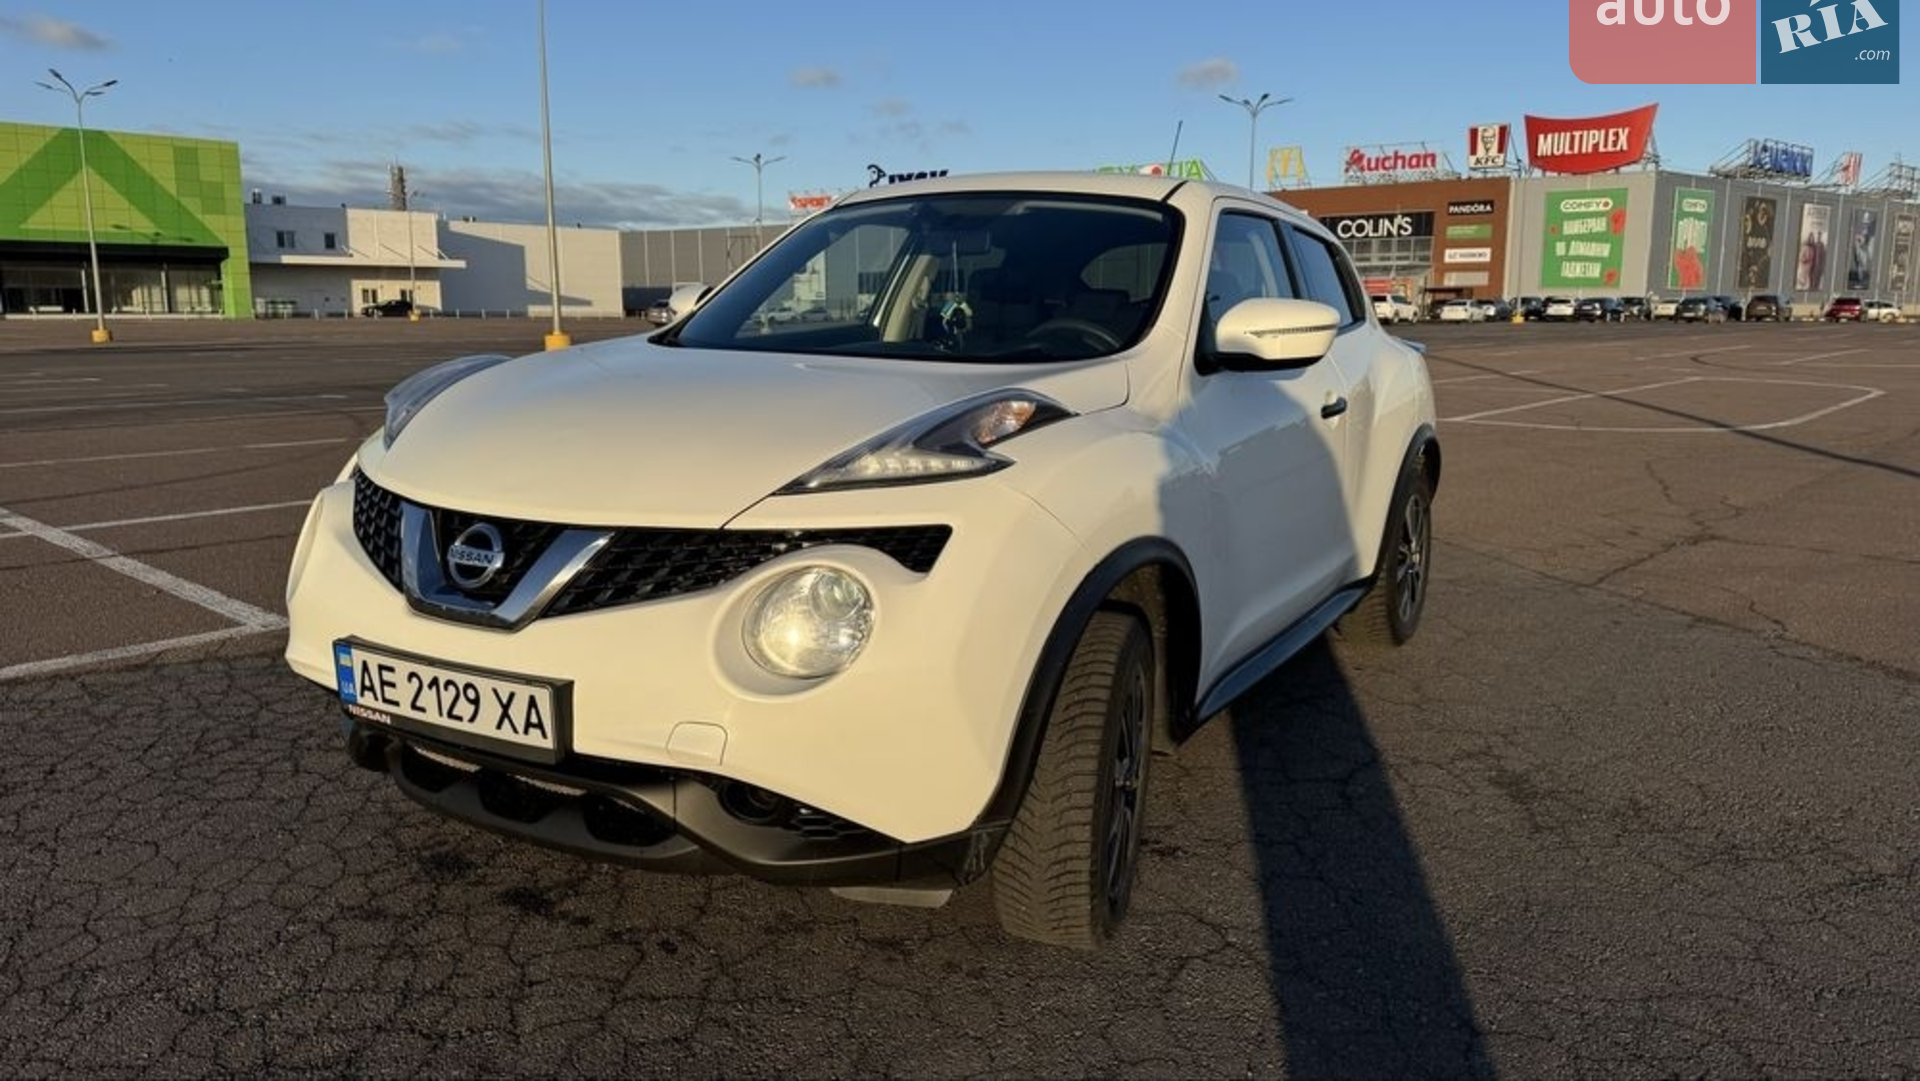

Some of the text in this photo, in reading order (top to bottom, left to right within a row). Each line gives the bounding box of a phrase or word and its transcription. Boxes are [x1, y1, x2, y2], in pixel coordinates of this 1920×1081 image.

[1536, 126, 1629, 157] MULTIPLEX
[1344, 148, 1437, 173] Auchan
[1473, 155, 1501, 167] KFC
[1449, 203, 1493, 214] PANDORA
[1337, 214, 1413, 238] COLIN'S
[450, 547, 496, 566] NISSAN
[360, 659, 549, 740] AE 2129 XA
[348, 703, 391, 725] NISSAN
